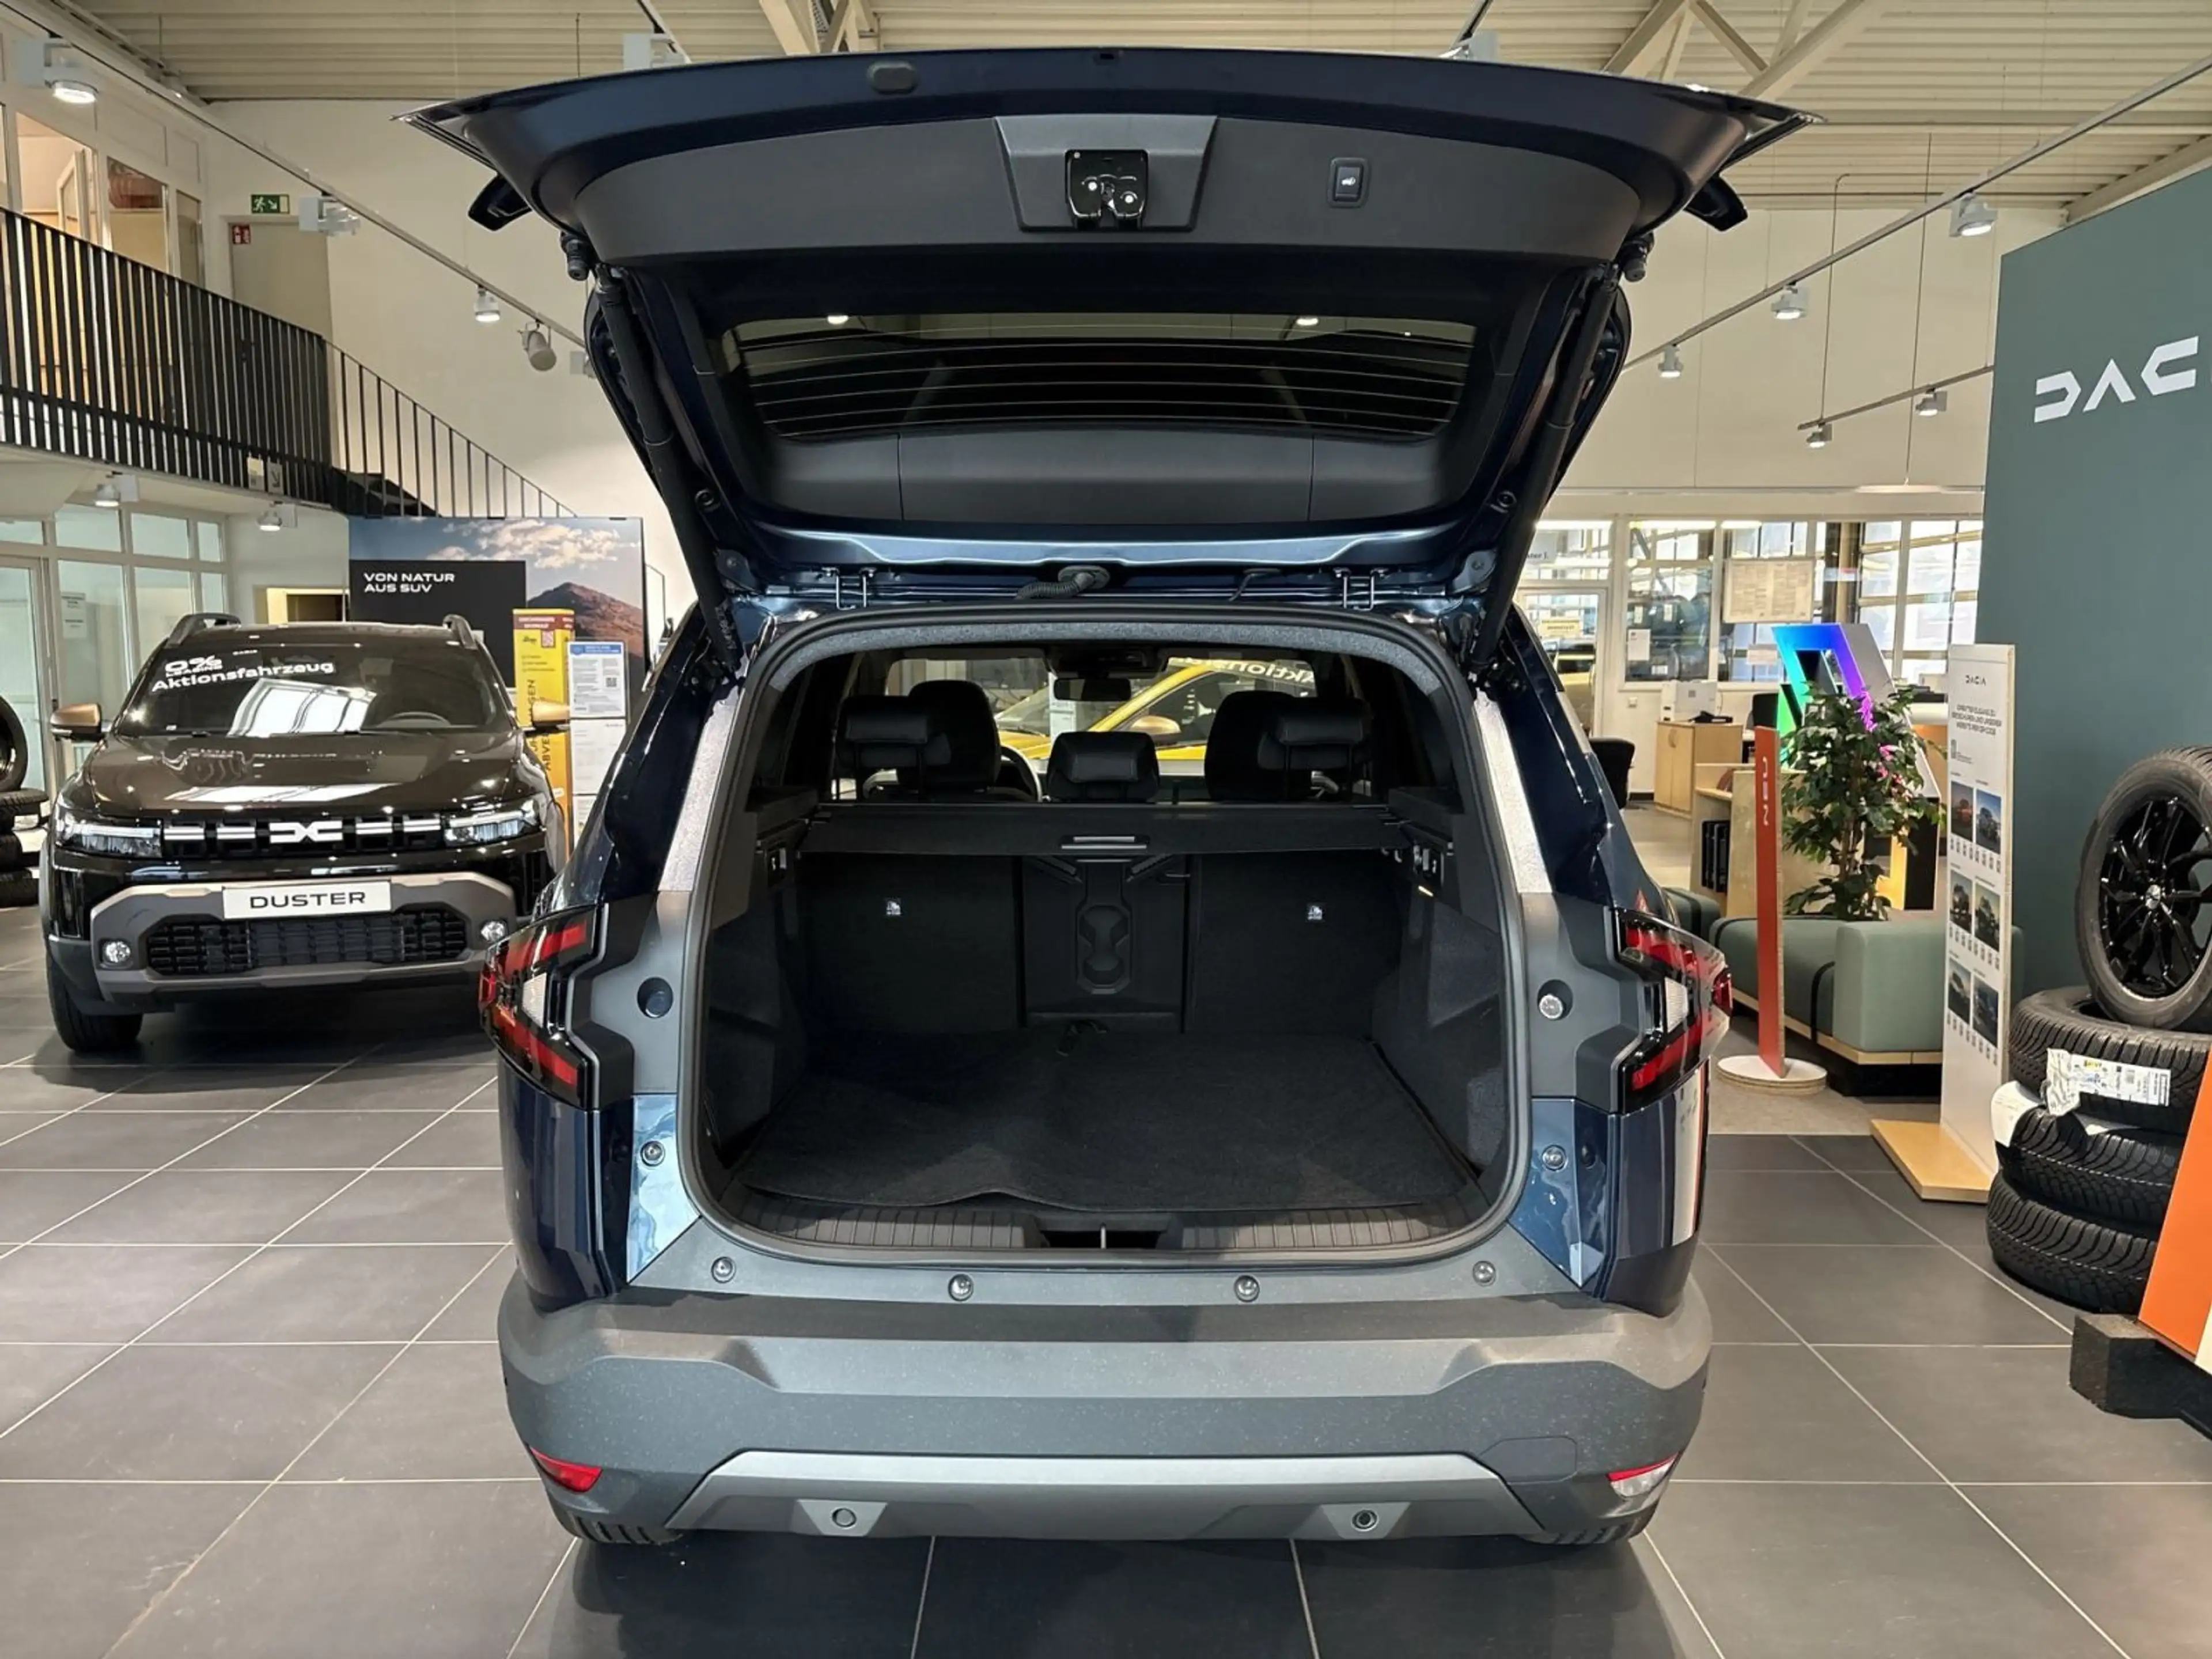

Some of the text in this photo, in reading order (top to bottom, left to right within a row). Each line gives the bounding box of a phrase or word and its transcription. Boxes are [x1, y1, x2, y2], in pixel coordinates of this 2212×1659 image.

[2034, 336, 2212, 423] DAC
[363, 572, 455, 582] VON NATUR
[364, 583, 432, 593] AUS SUV
[151, 662, 334, 692] Aktionsfahrzeug
[249, 892, 366, 909] DUSTER
